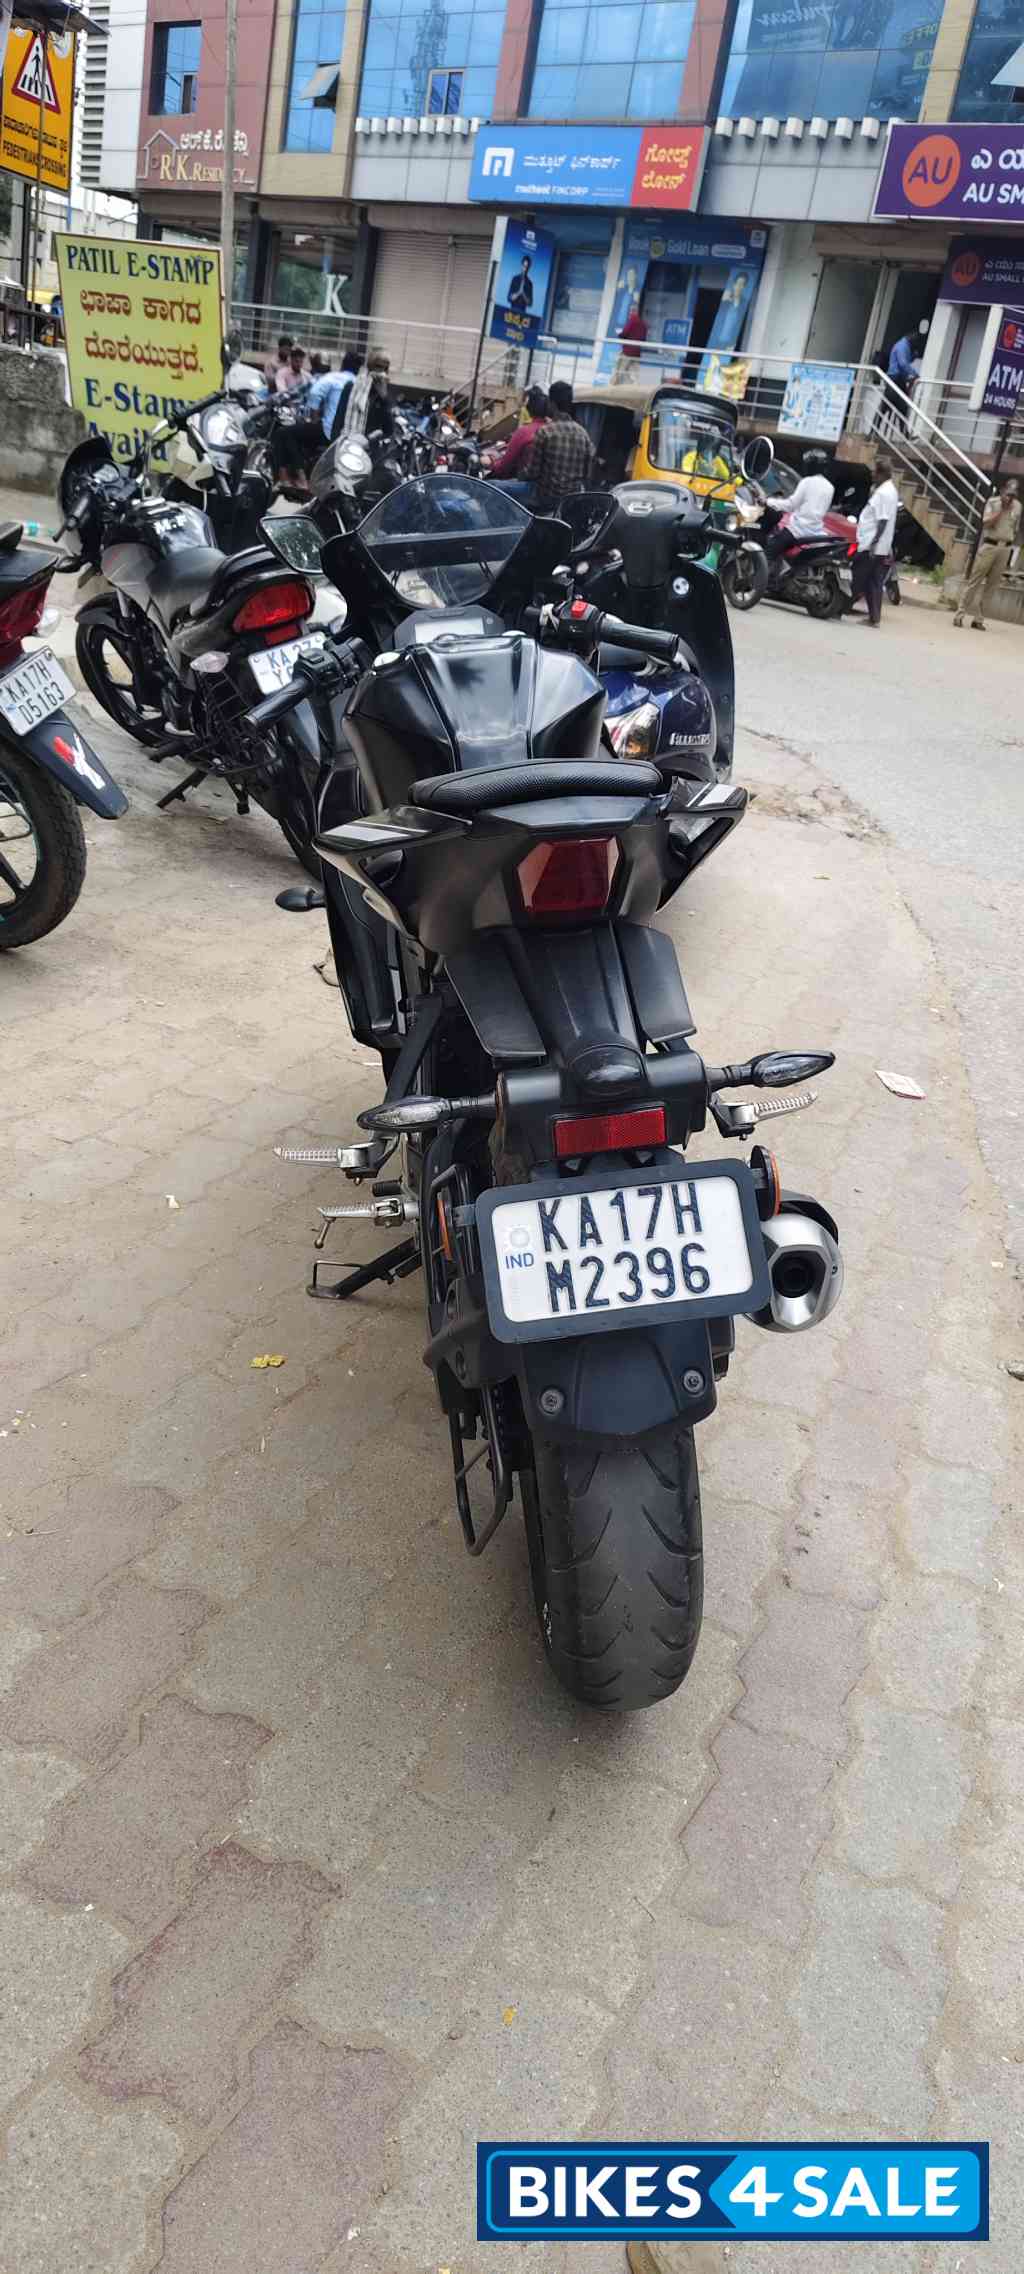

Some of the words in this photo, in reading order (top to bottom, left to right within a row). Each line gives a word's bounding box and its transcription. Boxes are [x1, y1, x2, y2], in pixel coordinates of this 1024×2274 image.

[908, 155, 955, 185] AU
[962, 182, 995, 203] AU
[65, 244, 121, 275] PATIL
[127, 251, 215, 286] E-STAMP
[143, 296, 202, 325] ಕಾಗದ
[321, 273, 349, 316] K
[988, 363, 1023, 393] ATM
[993, 394, 1017, 410] HOURS
[6, 658, 52, 703] KA17H
[18, 681, 65, 725] D5163
[537, 1182, 703, 1253] KA17H
[505, 1252, 535, 1270] IND
[545, 1242, 711, 1314] M2396
